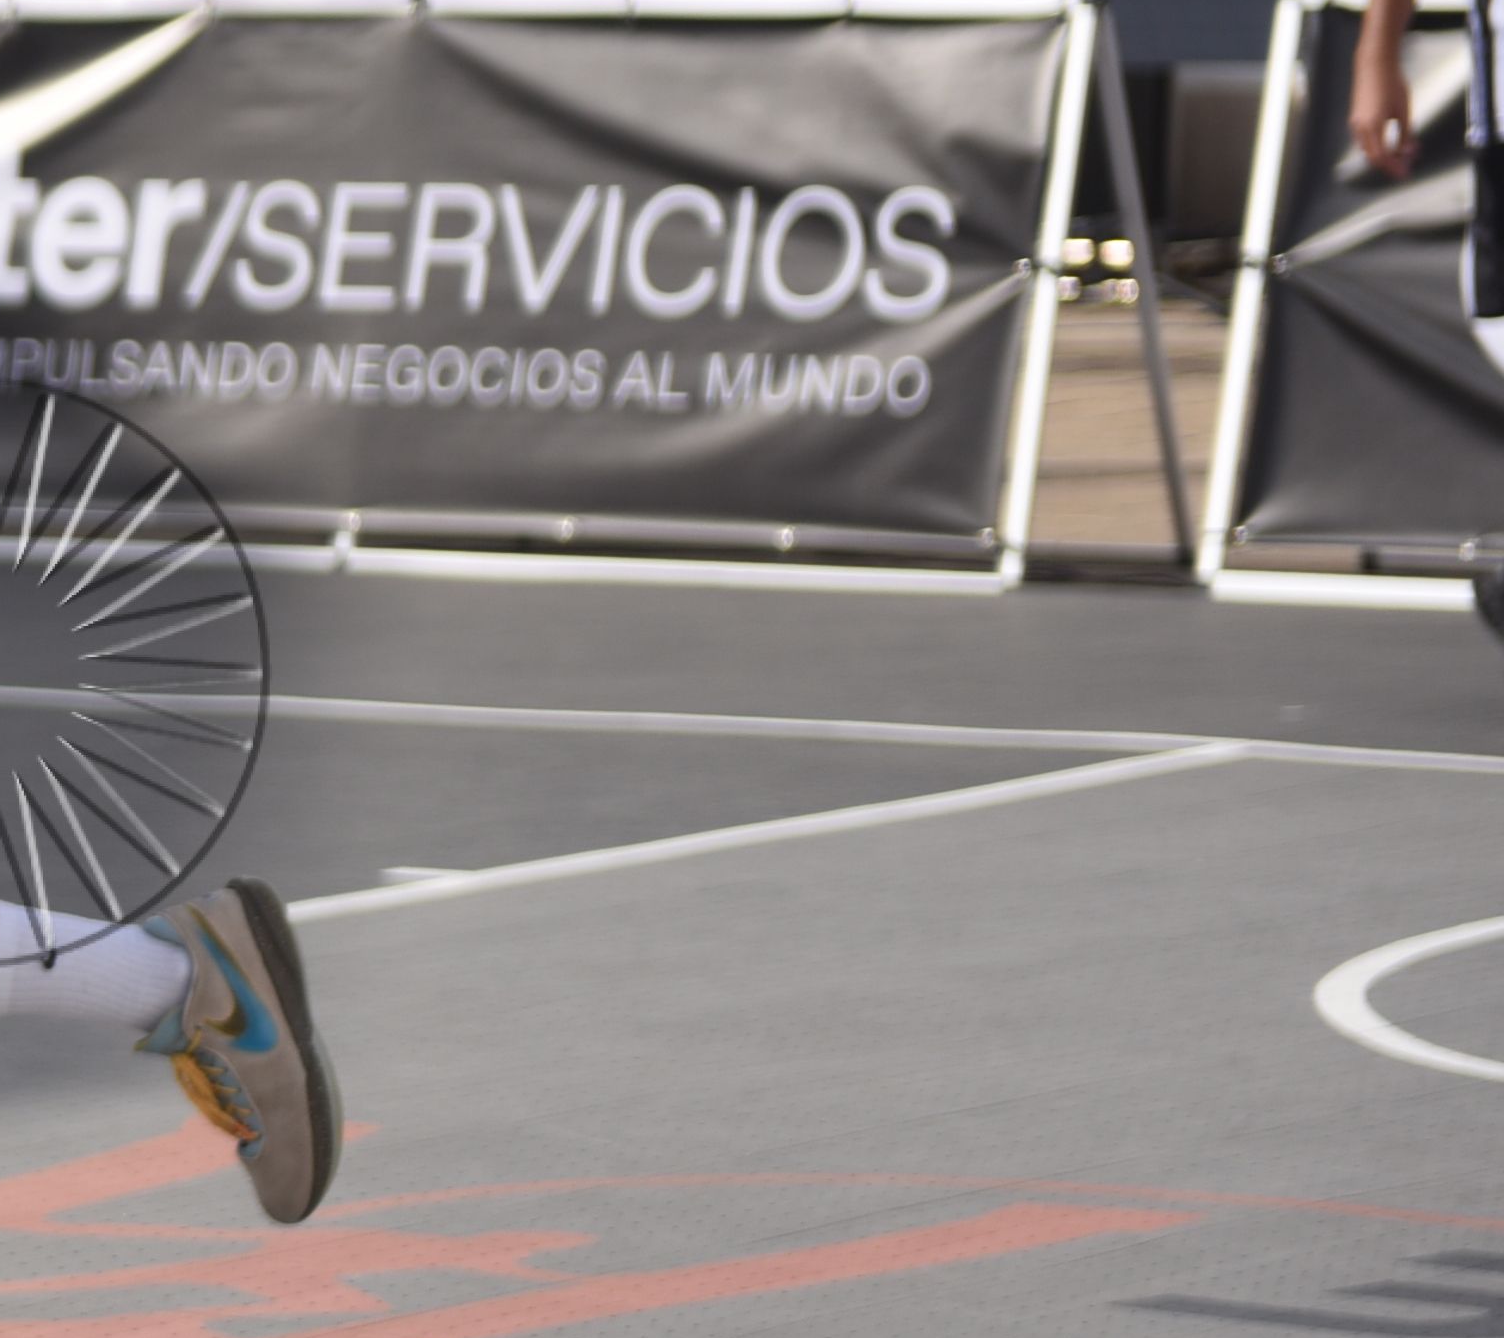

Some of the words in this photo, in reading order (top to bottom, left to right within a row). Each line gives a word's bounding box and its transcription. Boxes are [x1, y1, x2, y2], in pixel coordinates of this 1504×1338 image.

[309, 342, 605, 410] NEGOCIOS
[614, 348, 695, 413] AL
[703, 350, 931, 419] MUNDO
